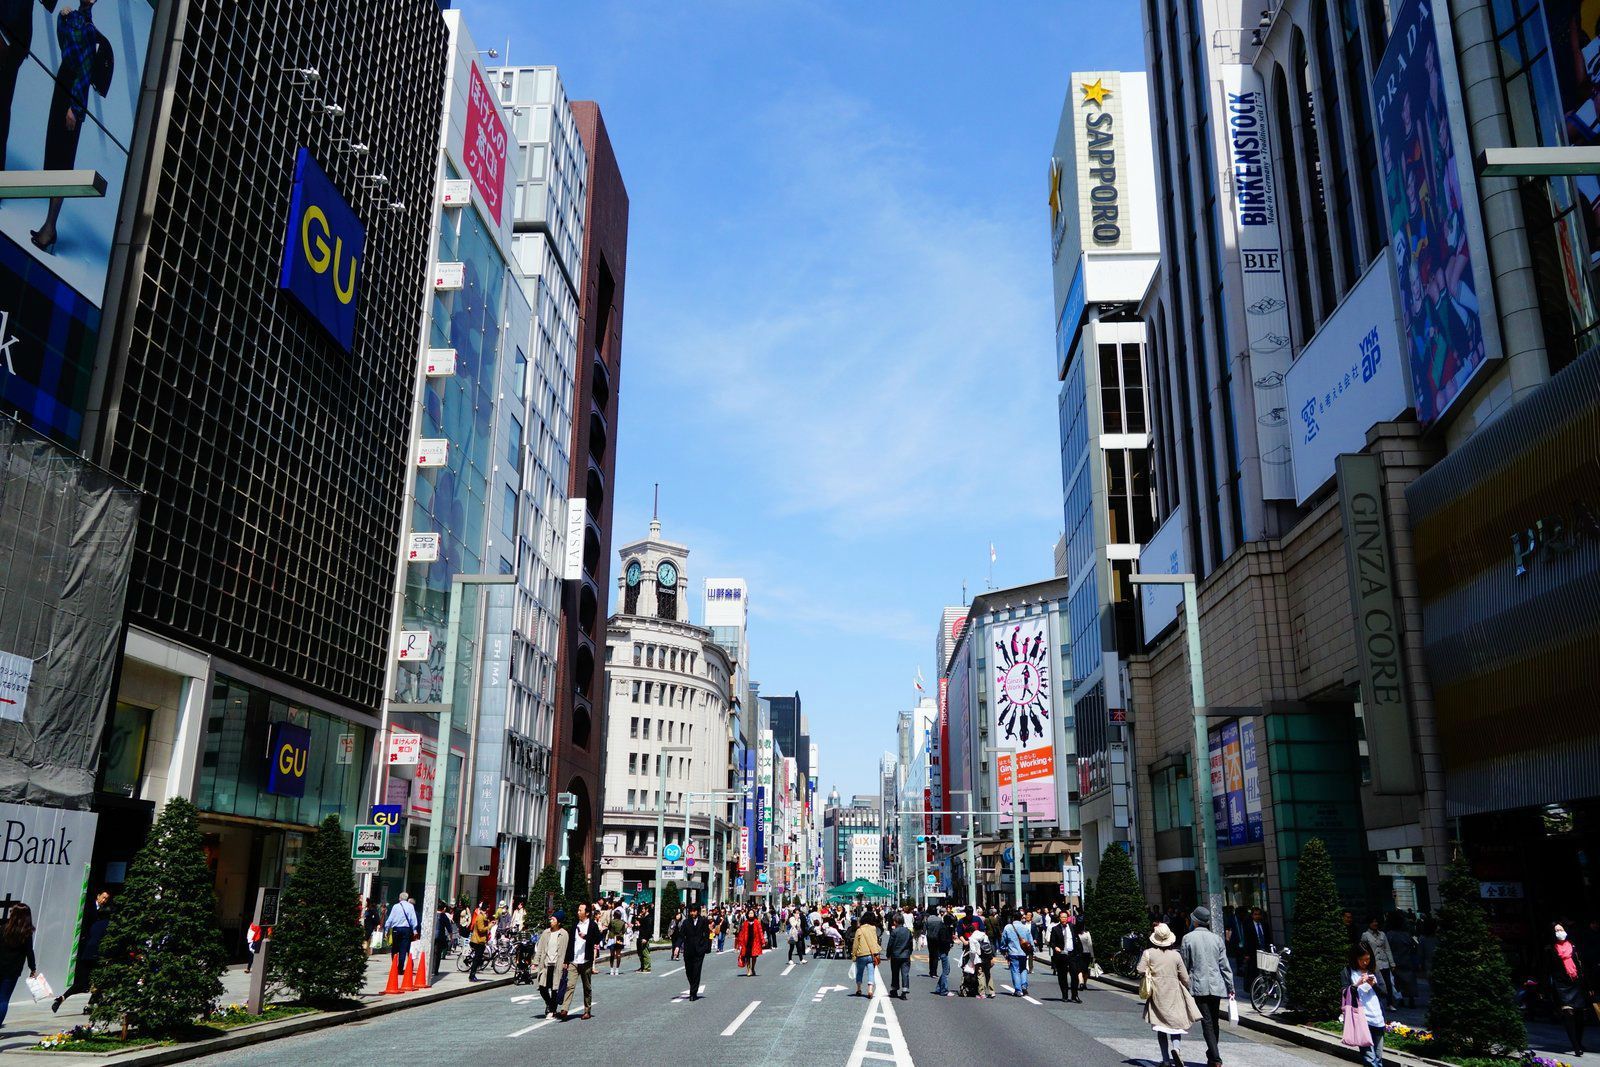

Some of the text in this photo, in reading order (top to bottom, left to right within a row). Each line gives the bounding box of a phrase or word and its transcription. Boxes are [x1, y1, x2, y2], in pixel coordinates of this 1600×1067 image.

[471, 72, 506, 160] ほけんの
[1227, 91, 1268, 227] BIRKENSTOCK
[1259, 122, 1268, 156] Tradition
[1086, 112, 1121, 246] SAPPORO
[1262, 161, 1273, 193] Germany
[302, 205, 357, 305] GU
[1243, 253, 1279, 269] B1F
[1359, 325, 1379, 357] YKK
[568, 508, 582, 568] TASAKI
[1350, 492, 1388, 600] GINZA
[407, 634, 417, 651] R
[1364, 608, 1401, 707] CORE
[491, 639, 502, 687] SHIMA
[279, 743, 307, 778] GU
[373, 812, 399, 826] GU
[757, 798, 765, 832] MIKIMOTO
[0, 820, 73, 866] Bank
[854, 836, 878, 846] LIXIL
